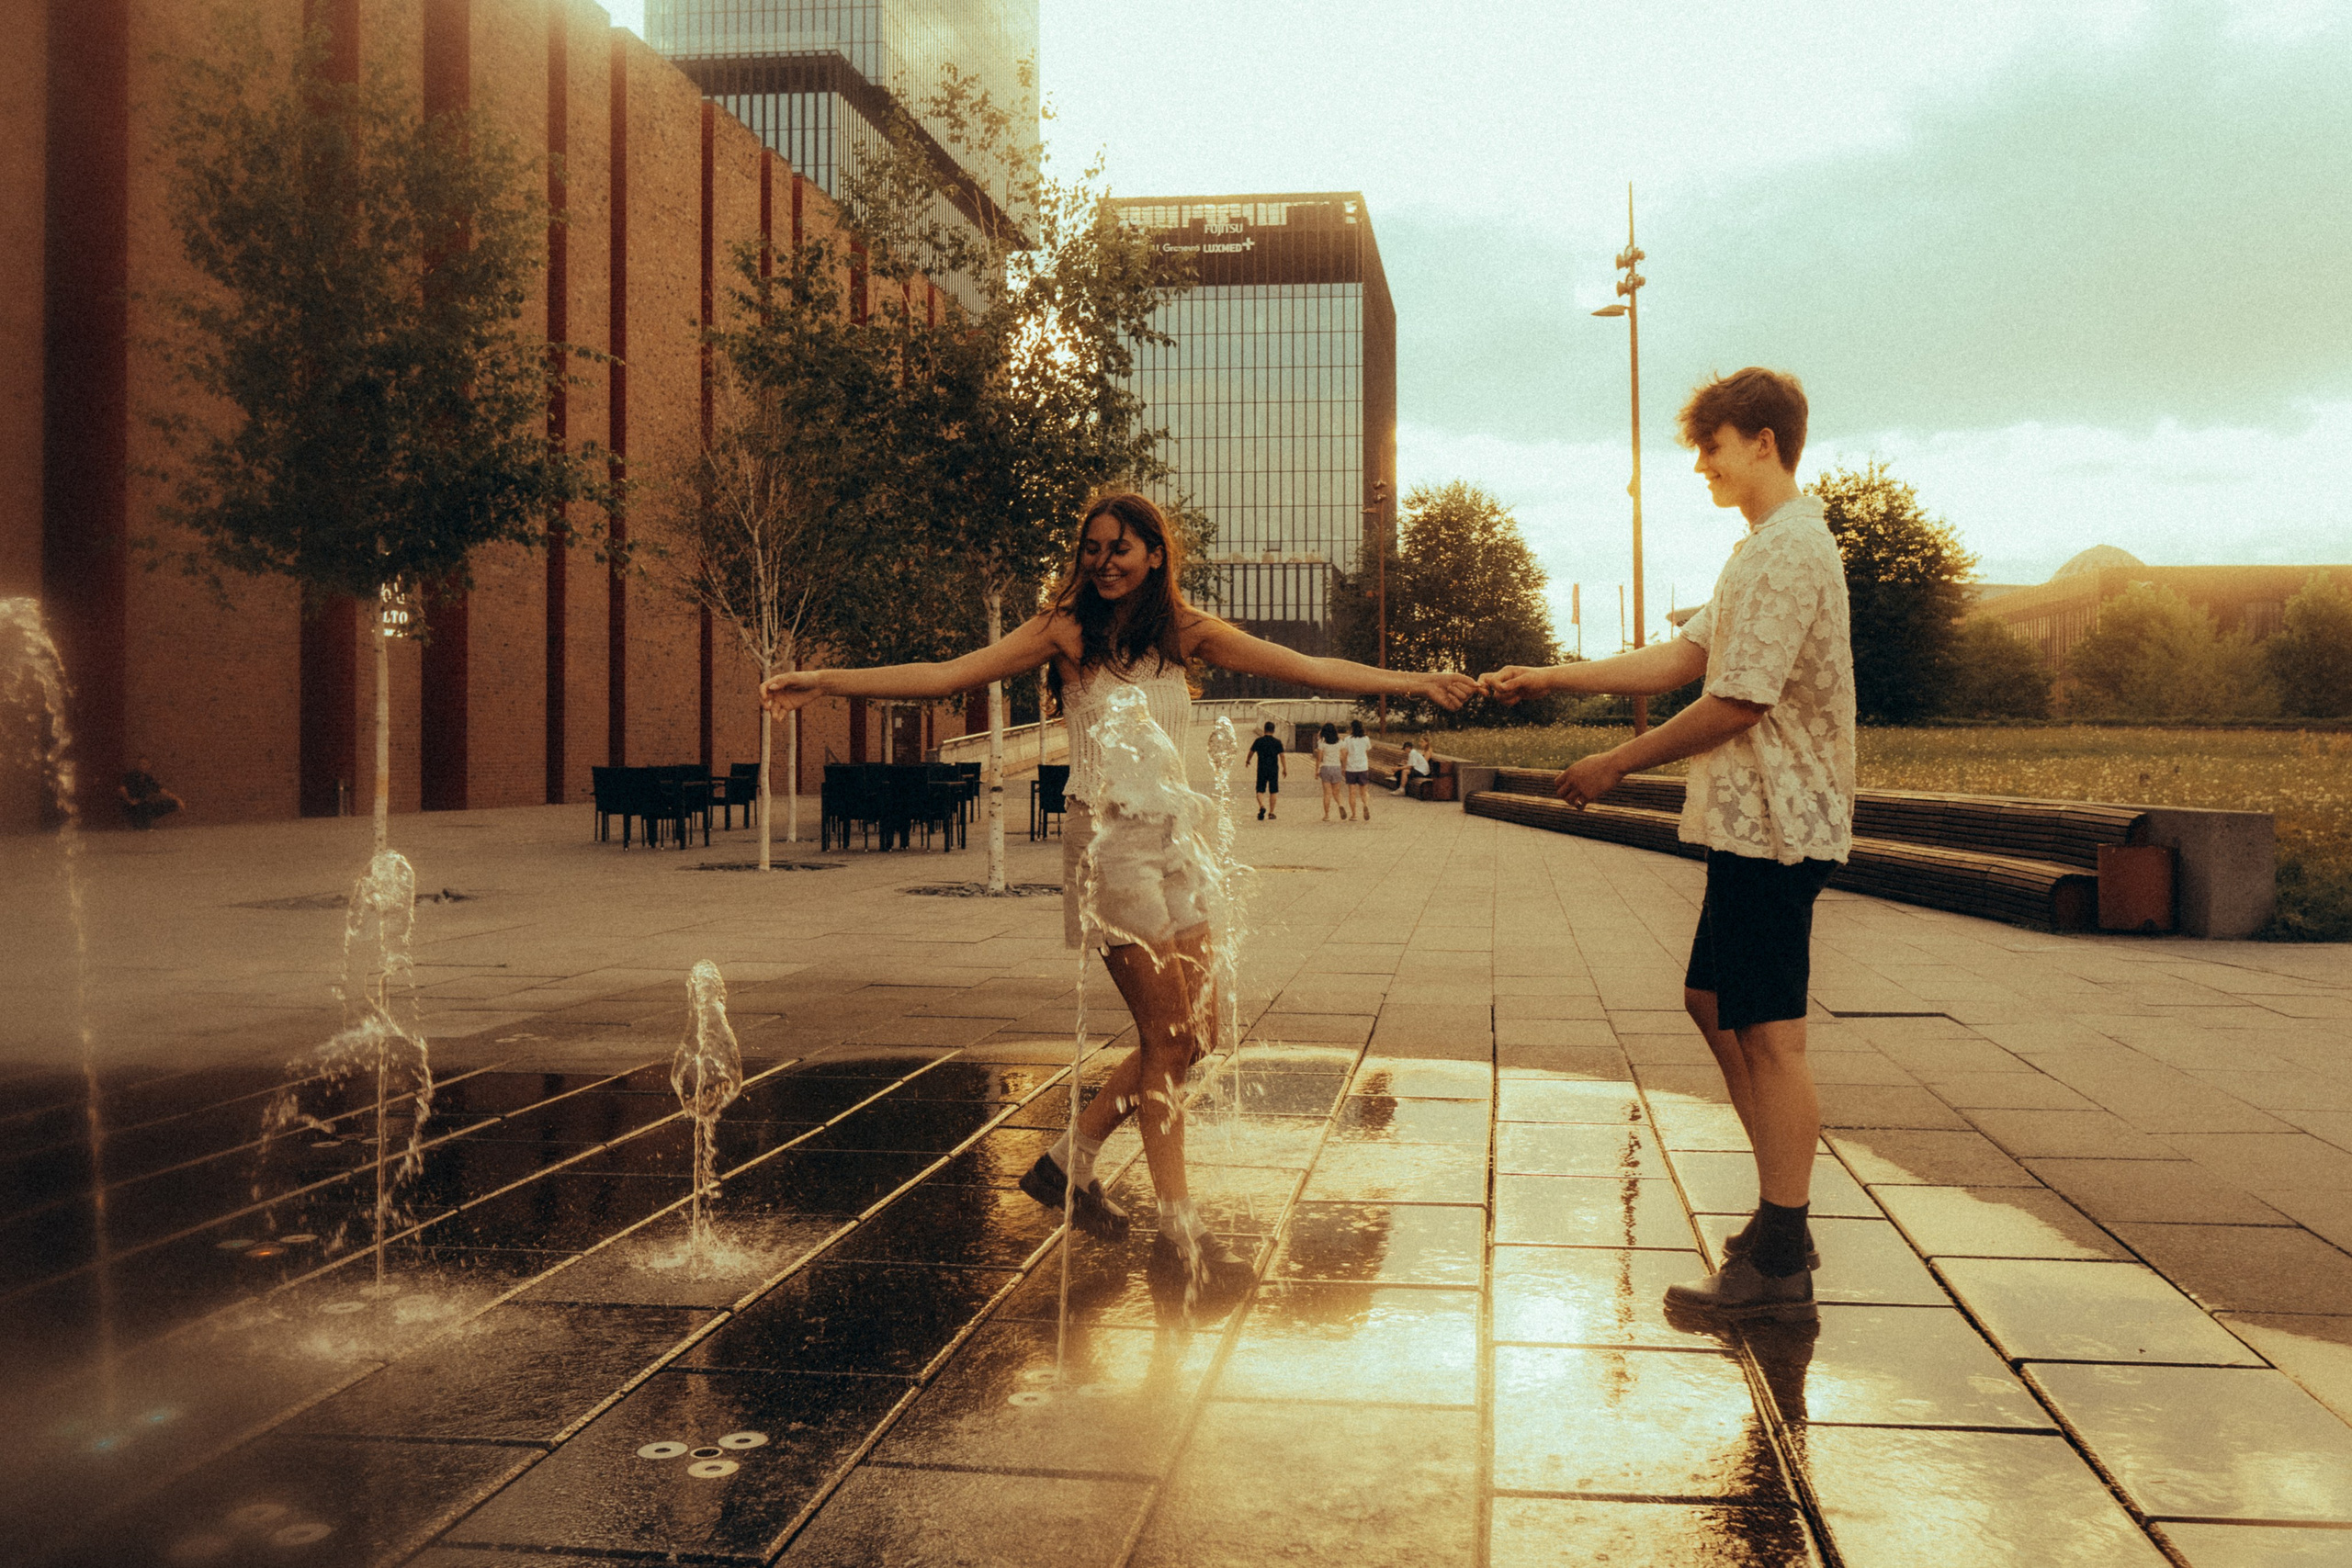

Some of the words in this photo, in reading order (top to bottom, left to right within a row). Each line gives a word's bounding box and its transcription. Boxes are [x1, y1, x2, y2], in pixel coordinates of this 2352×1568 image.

[1204, 223, 1243, 236] FUJITSU
[1203, 243, 1243, 253] LUXMED
[382, 610, 408, 625] LTO
